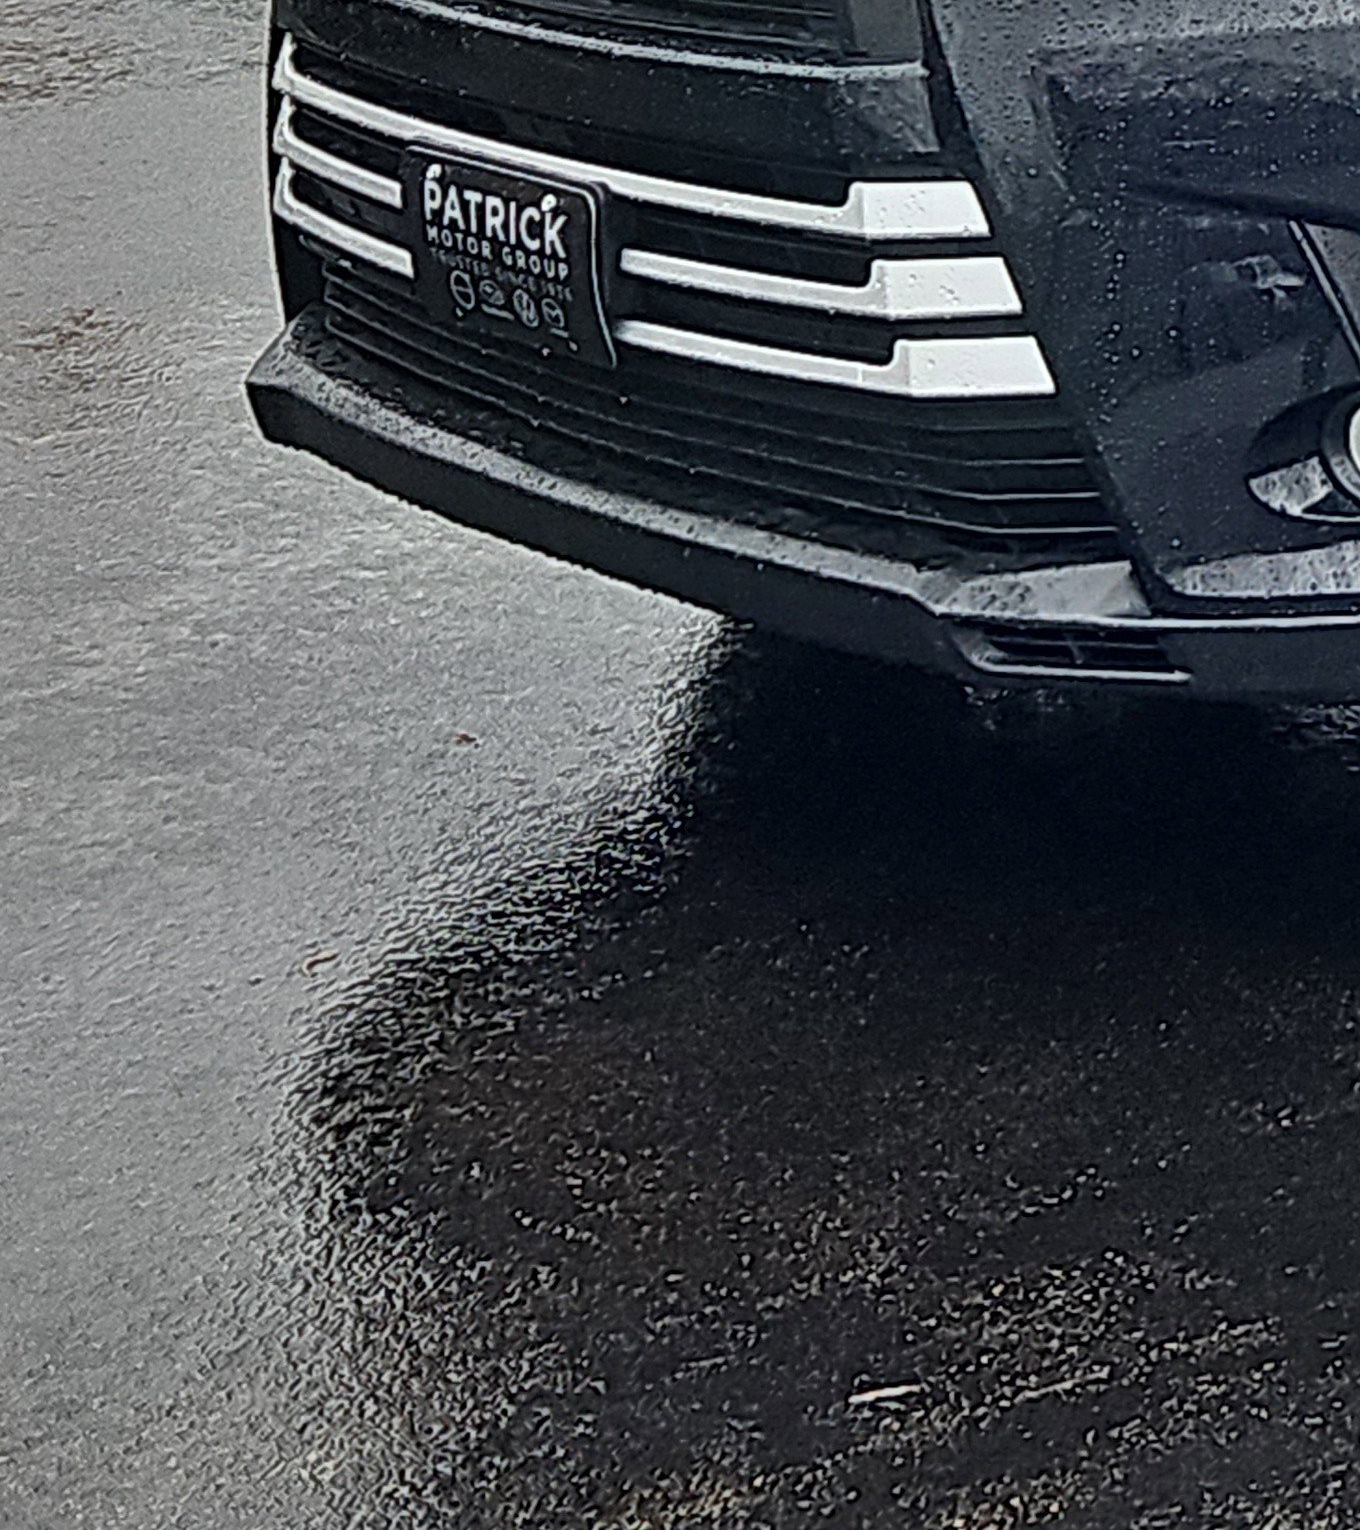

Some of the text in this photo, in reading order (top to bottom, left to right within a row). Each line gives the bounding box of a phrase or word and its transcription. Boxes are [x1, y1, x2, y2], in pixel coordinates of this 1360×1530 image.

[423, 179, 568, 259] PATRICK
[426, 224, 569, 281] MOTOR GROUP
